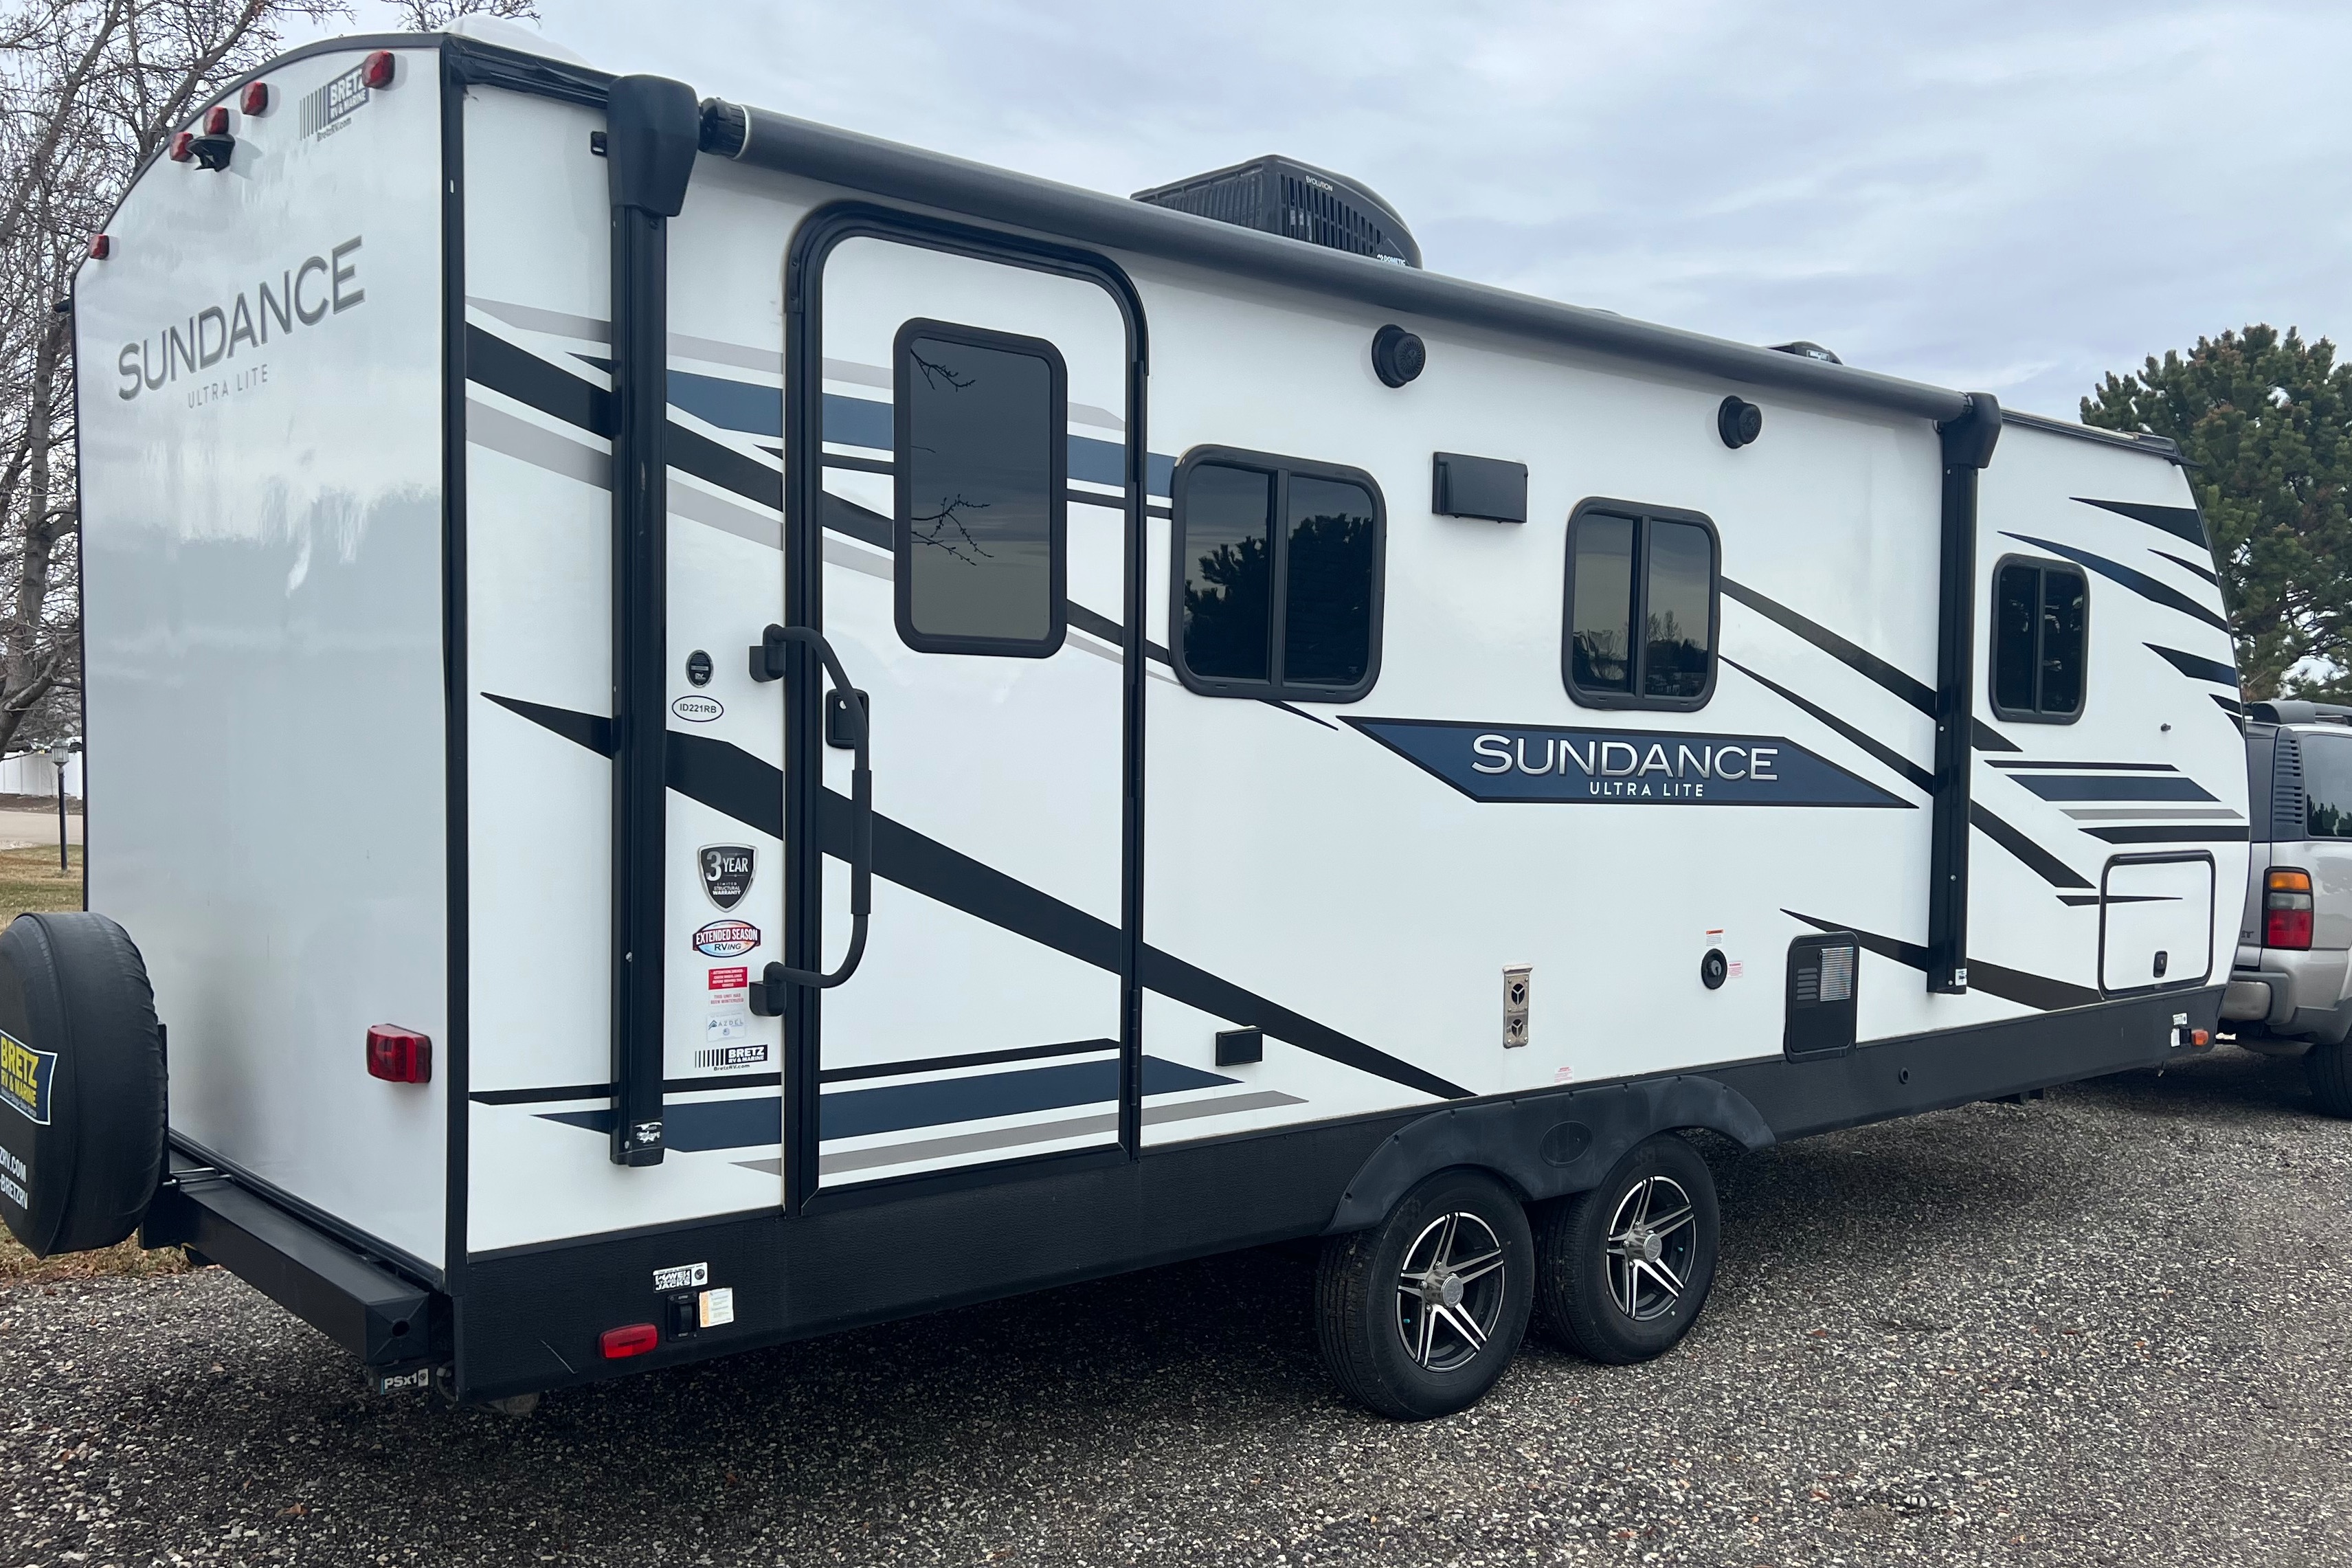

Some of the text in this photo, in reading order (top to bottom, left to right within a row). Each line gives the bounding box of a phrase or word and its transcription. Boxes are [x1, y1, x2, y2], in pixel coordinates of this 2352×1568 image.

[1306, 175, 1333, 192] EVOLUTION
[119, 235, 365, 401] SUNDANCE
[188, 363, 268, 409] ULTRA LITE
[680, 703, 717, 714] ID221RB
[1471, 734, 1779, 781] SUNDANCE
[1589, 781, 1704, 797] ULTRA LITE
[706, 851, 748, 882] 3 YEAR
[696, 928, 758, 945] EXTENDED SEASON
[728, 1046, 764, 1059] BRETZ
[1, 1035, 39, 1089] BRETZ
[655, 1280, 691, 1290] JACKS
